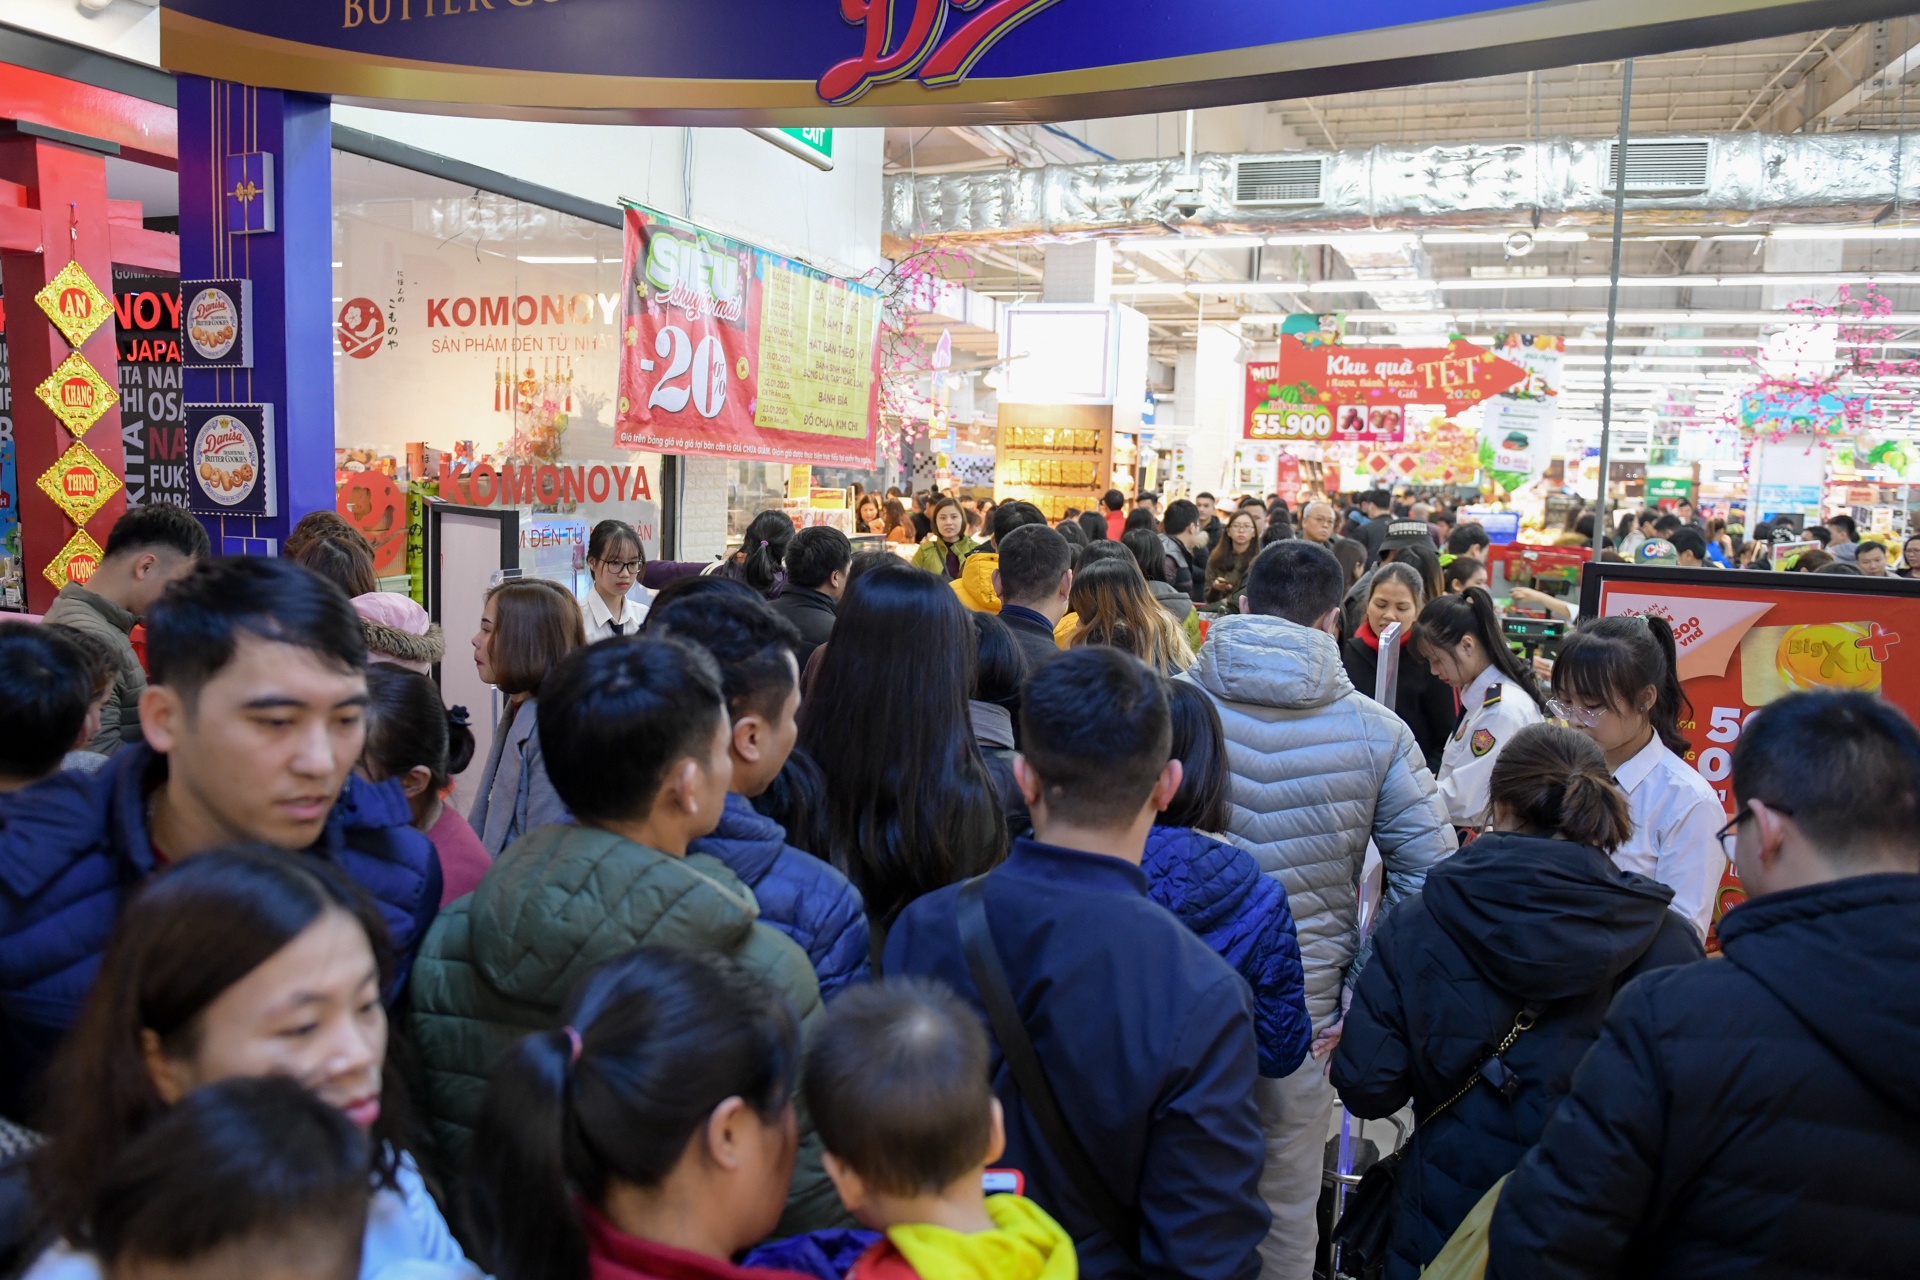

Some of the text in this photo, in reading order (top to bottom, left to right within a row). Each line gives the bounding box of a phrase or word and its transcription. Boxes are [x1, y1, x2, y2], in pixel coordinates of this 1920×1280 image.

[64, 293, 87, 318] AN
[113, 291, 181, 330] NOY
[195, 299, 227, 320] Danisa
[427, 292, 621, 328] KOMONOY
[127, 340, 181, 363] JAPA
[432, 335, 460, 353] SẢN
[1326, 355, 1369, 376] Khu
[1374, 358, 1415, 380] quà
[1416, 352, 1481, 389] TẾT
[65, 384, 93, 407] KHANG
[1446, 389, 1481, 399] 2020
[1252, 413, 1332, 436] 35.900
[203, 428, 245, 455] Danisa
[205, 454, 224, 463] BUTTER
[66, 473, 96, 496] THỊNH
[439, 463, 652, 507] KOMONOYA
[530, 525, 561, 548] ĐẾN
[630, 520, 652, 541] ẢN
[1672, 616, 1700, 640] 300
[1679, 626, 1703, 647] vnd
[1789, 638, 1823, 658] Big
